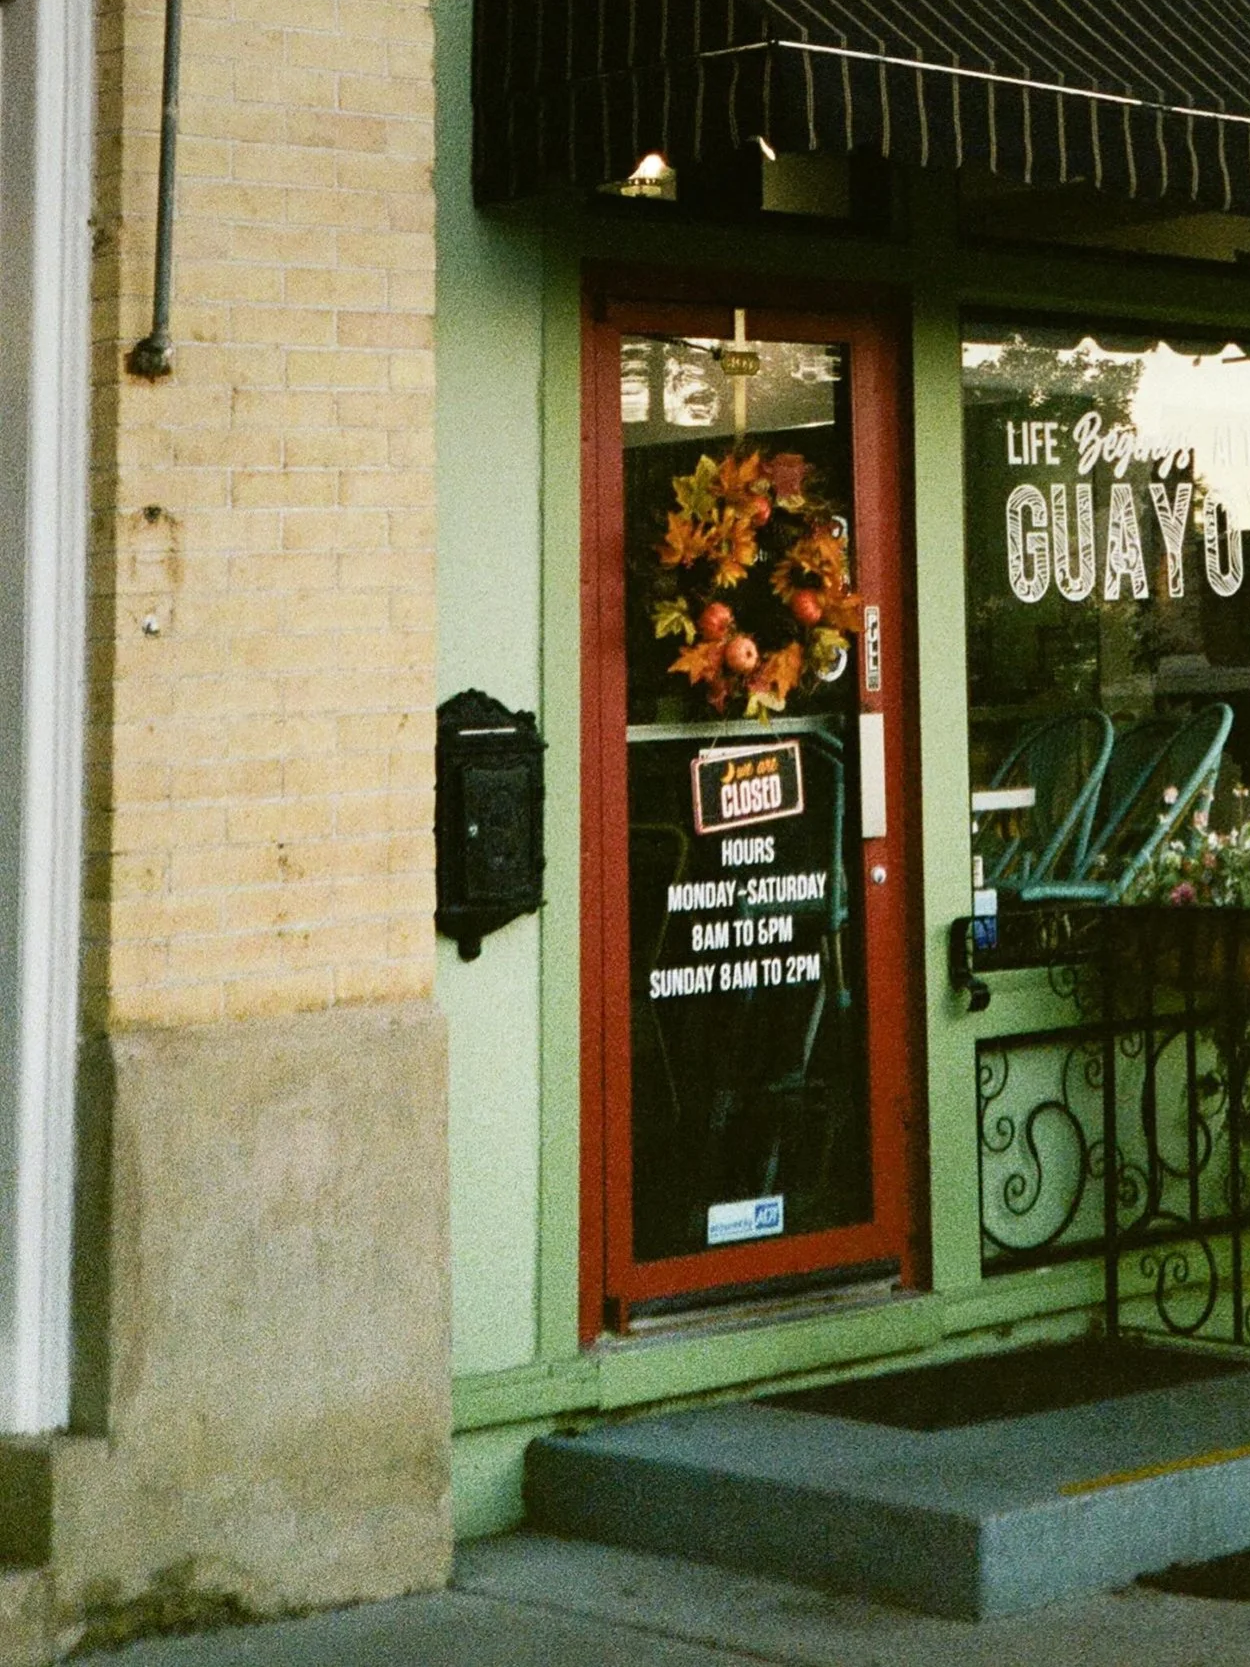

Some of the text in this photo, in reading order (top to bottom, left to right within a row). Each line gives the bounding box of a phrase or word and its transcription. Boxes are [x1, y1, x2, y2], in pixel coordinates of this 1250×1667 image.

[1007, 421, 1061, 465] LIFE
[721, 775, 782, 819] CLOSED
[721, 836, 775, 866] HOURS
[692, 915, 793, 952] 8AM TO 6PM
[650, 953, 820, 999] SUNDAY 8AM TO 2PM
